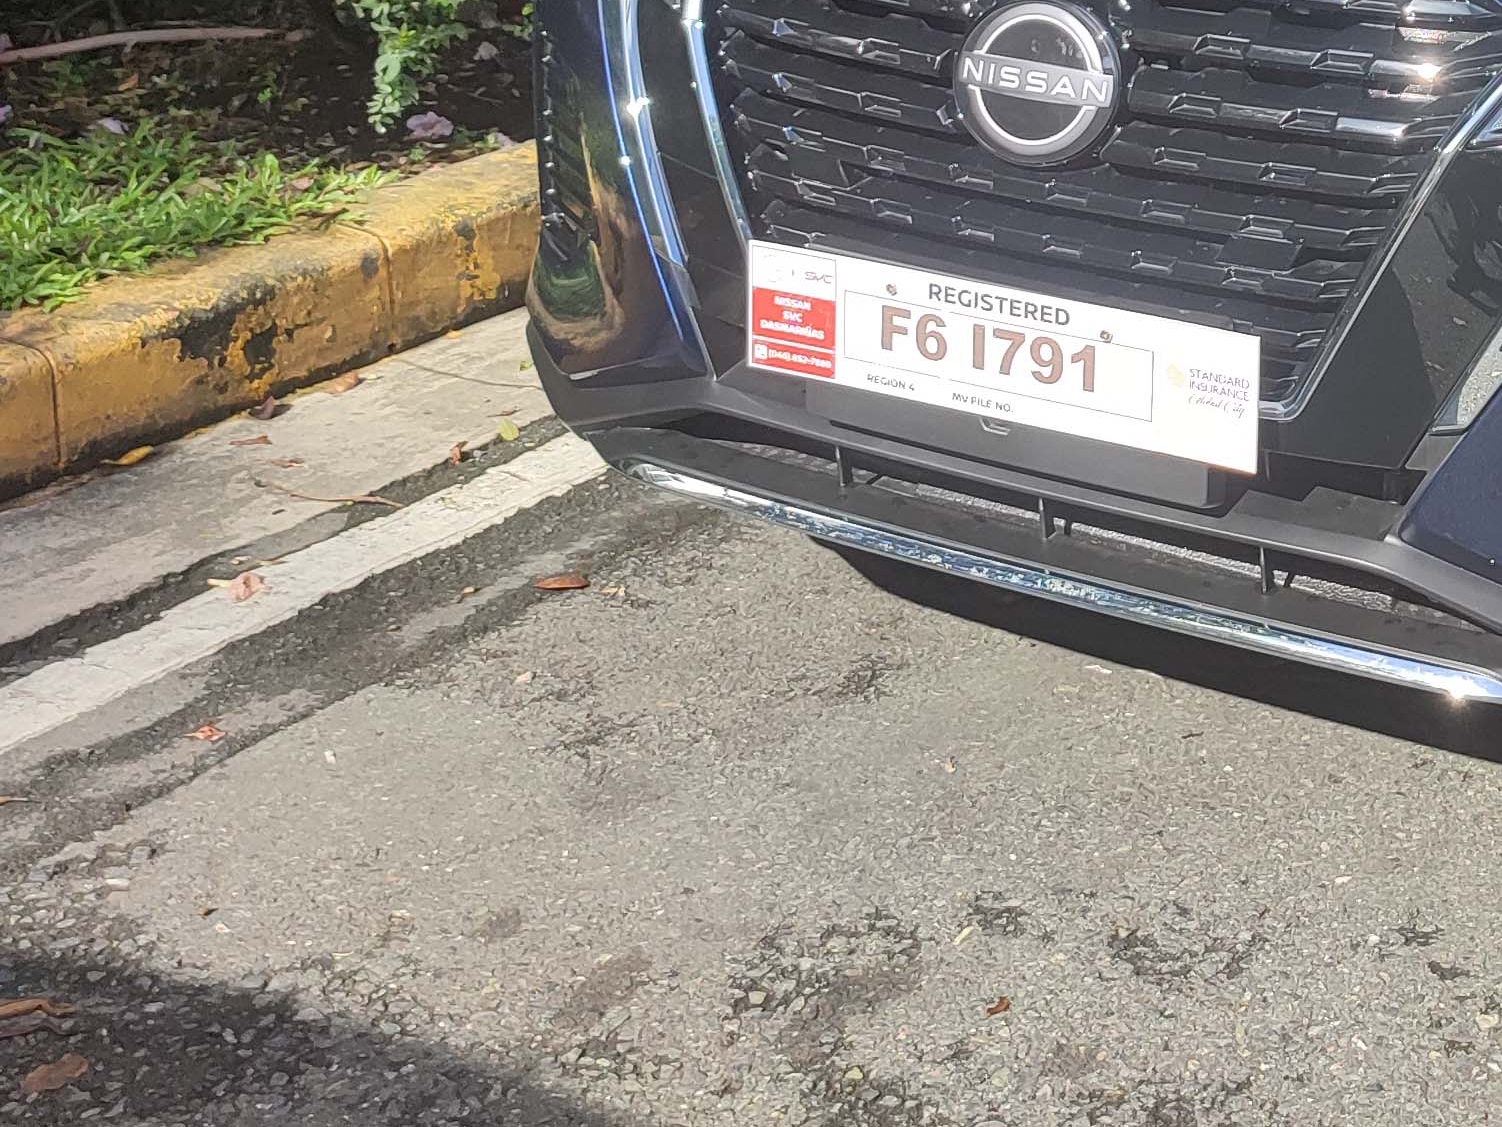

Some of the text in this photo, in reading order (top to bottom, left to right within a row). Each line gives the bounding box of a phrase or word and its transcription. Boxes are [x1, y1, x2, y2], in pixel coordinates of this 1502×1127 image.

[963, 58, 1108, 102] NISSAN
[928, 283, 1070, 326] REGISTERED
[881, 305, 947, 361] F6
[867, 373, 915, 392] REGION 4
[1189, 368, 1250, 390] STANDARD
[1189, 379, 1249, 402] INSURANCE
